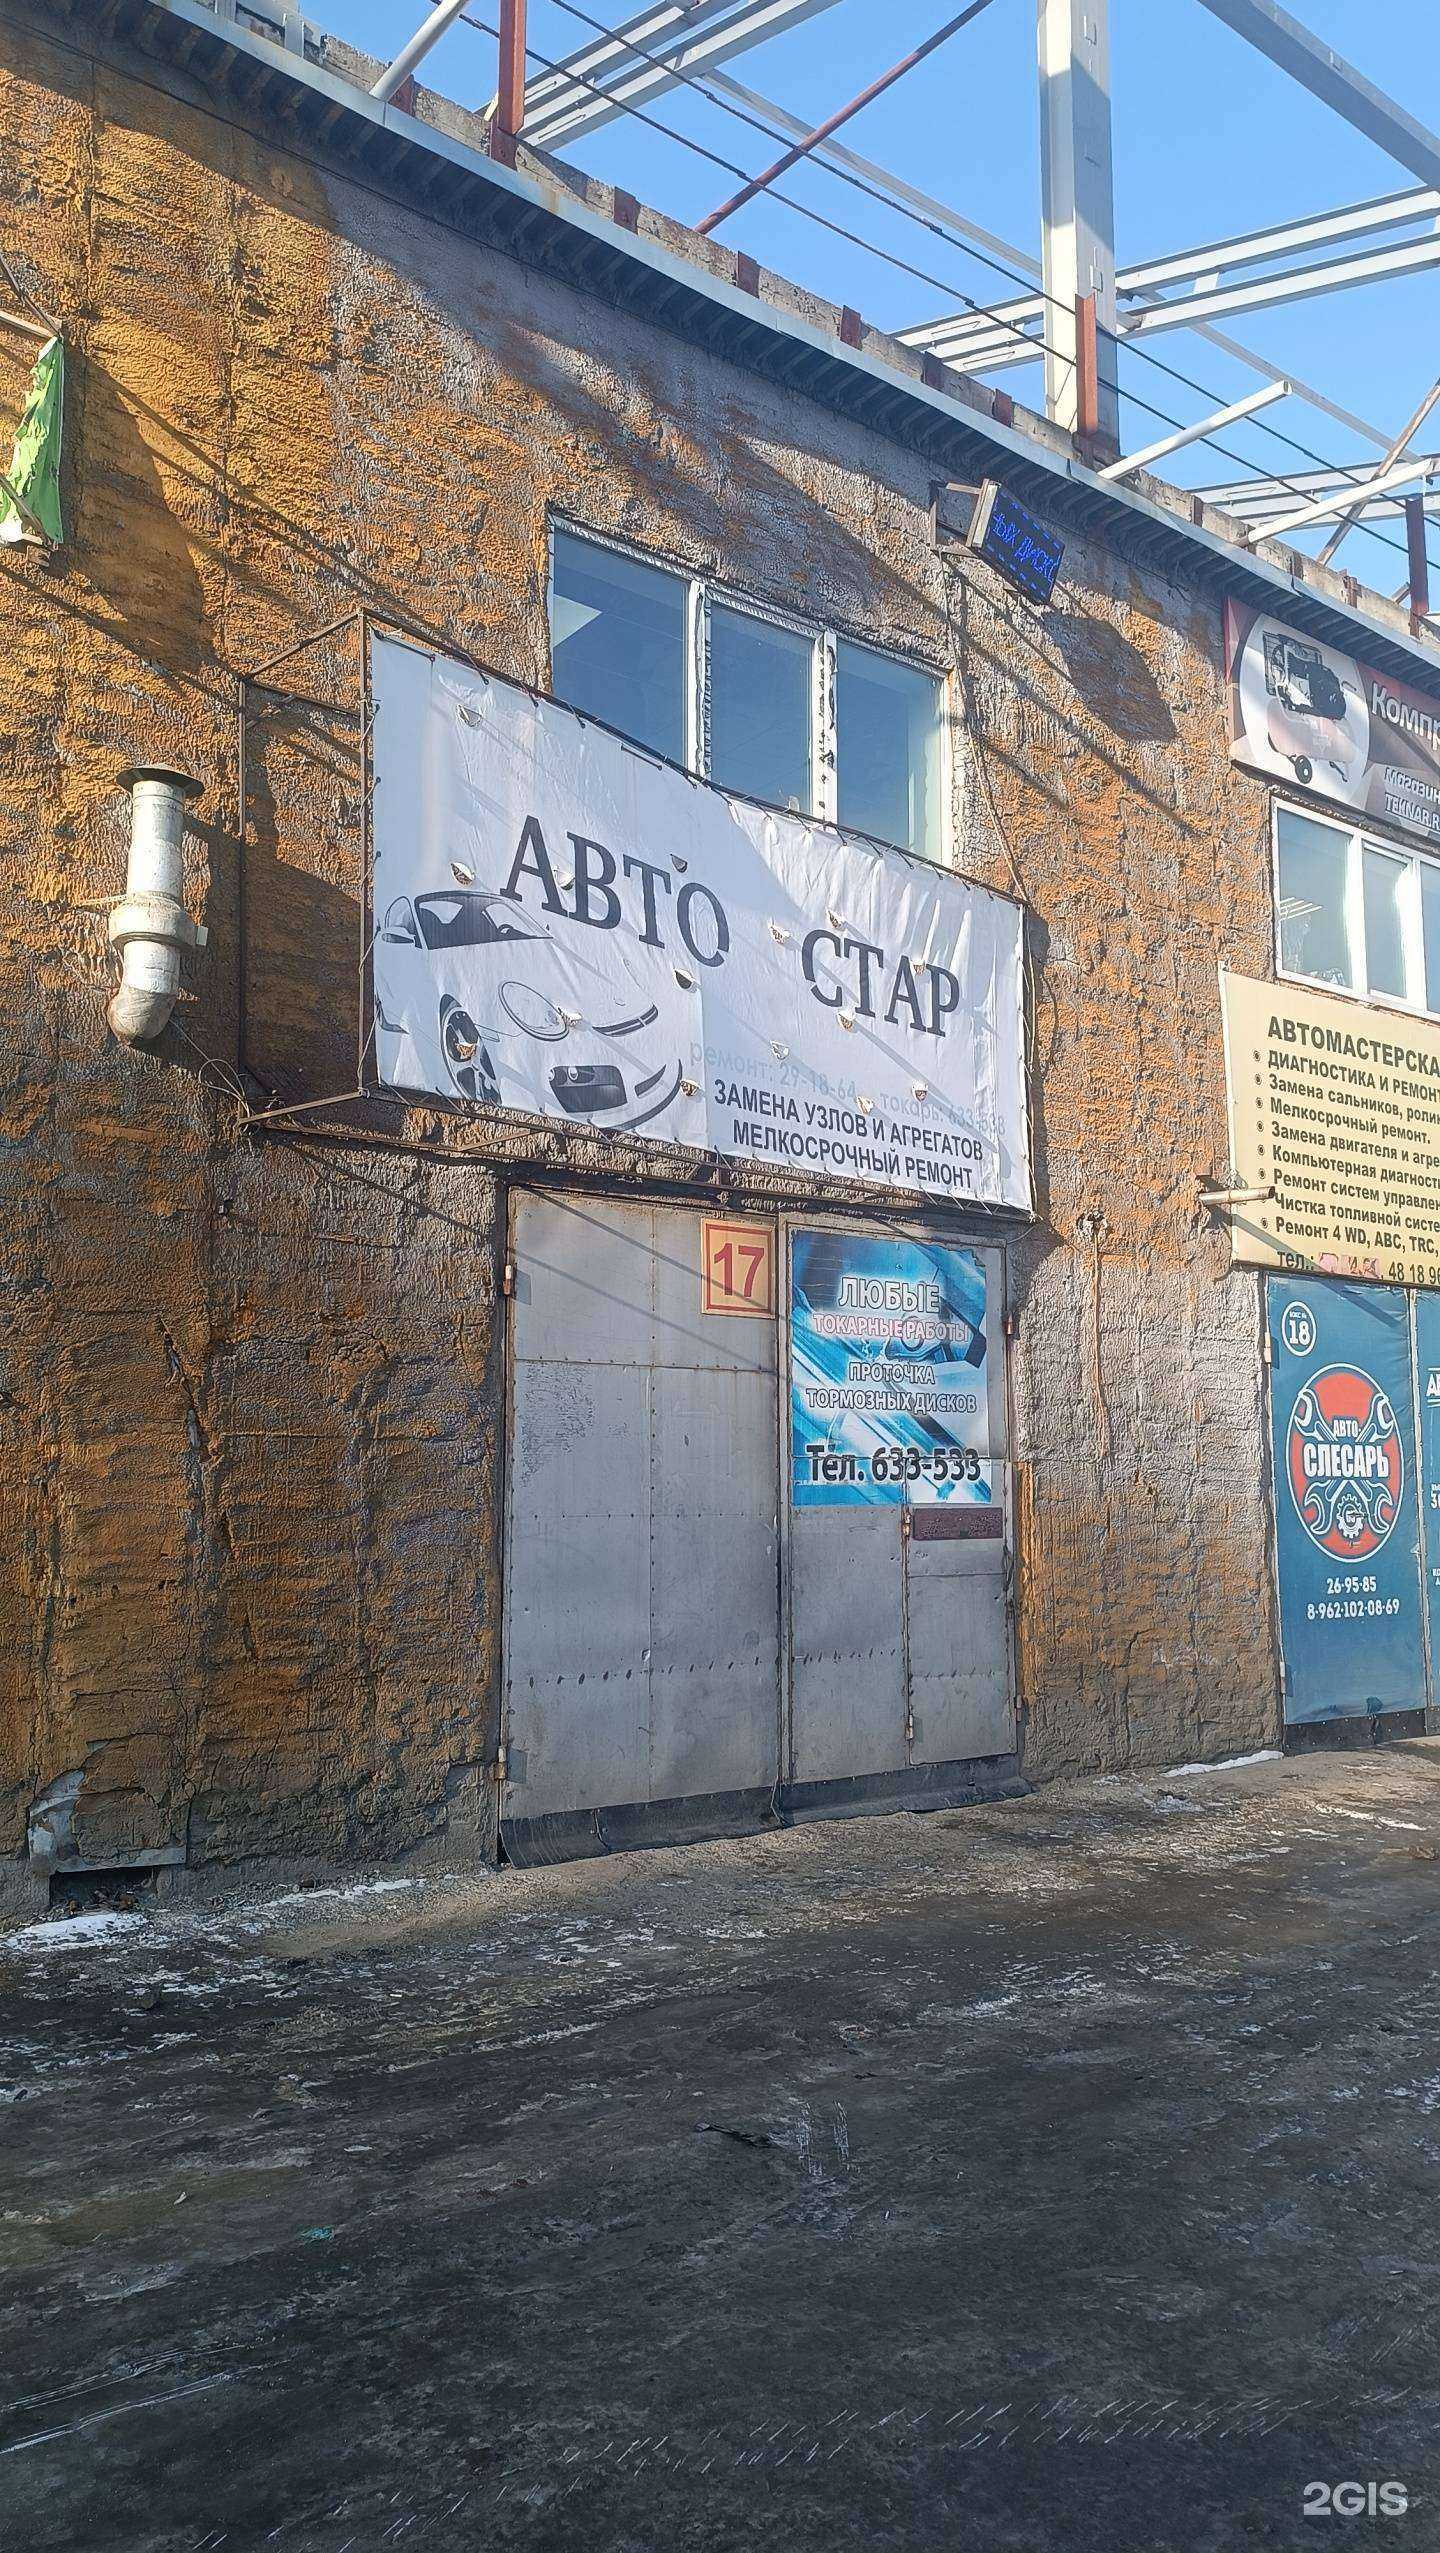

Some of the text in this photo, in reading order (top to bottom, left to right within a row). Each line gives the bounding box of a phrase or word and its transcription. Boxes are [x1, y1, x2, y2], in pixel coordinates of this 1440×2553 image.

[500, 815, 960, 1037] АВТО СТАР
[1267, 1016, 1440, 1078] АВТОМАСТЕРСКА
[1268, 1050, 1375, 1089] ДИАГНОСТИКА
[1379, 1075, 1389, 1092] И
[1269, 1074, 1323, 1100] Замена
[1328, 1090, 1402, 1119] сальников,
[714, 1079, 983, 1161] ЗАМЕНА УЗЛОВ И АГРЕГАТОВ
[1270, 1097, 1431, 1144] Мелкосрочный ремонт.
[733, 1119, 972, 1189] МЕЛКОСРОЧНЫЙ РЕМОНТ
[1271, 1121, 1325, 1146] Замена
[1330, 1136, 1397, 1160] двигателя
[1401, 1149, 1409, 1161] и
[1273, 1145, 1376, 1178] Компьютерная
[1273, 1168, 1326, 1192] Ремонт
[1331, 1182, 1379, 1197] систем
[1275, 1192, 1326, 1216] Чистка
[1330, 1205, 1401, 1227] топливной
[1276, 1216, 1329, 1240] Ремонт
[1333, 1225, 1341, 1241] 4
[1345, 1226, 1370, 1248] WD,
[1409, 1236, 1439, 1258] TRC,
[714, 1243, 764, 1297] 17
[1277, 1251, 1314, 1272] тел.:
[1388, 1261, 1405, 1281] 48
[1410, 1263, 1425, 1284] 18
[839, 1277, 940, 1313] ЛЮБЫЕ
[813, 1314, 969, 1342] ТОКАРНЫЕ РАБОТЫ
[1290, 1319, 1311, 1346] 18
[849, 1361, 936, 1384] ПРОТОЧКА
[806, 1388, 976, 1415] ТОРМОЗНЫХ ДИСКОВ
[806, 1445, 981, 1482] Тел. 633-533
[1303, 1443, 1389, 1478] СЛЕСАРЬ
